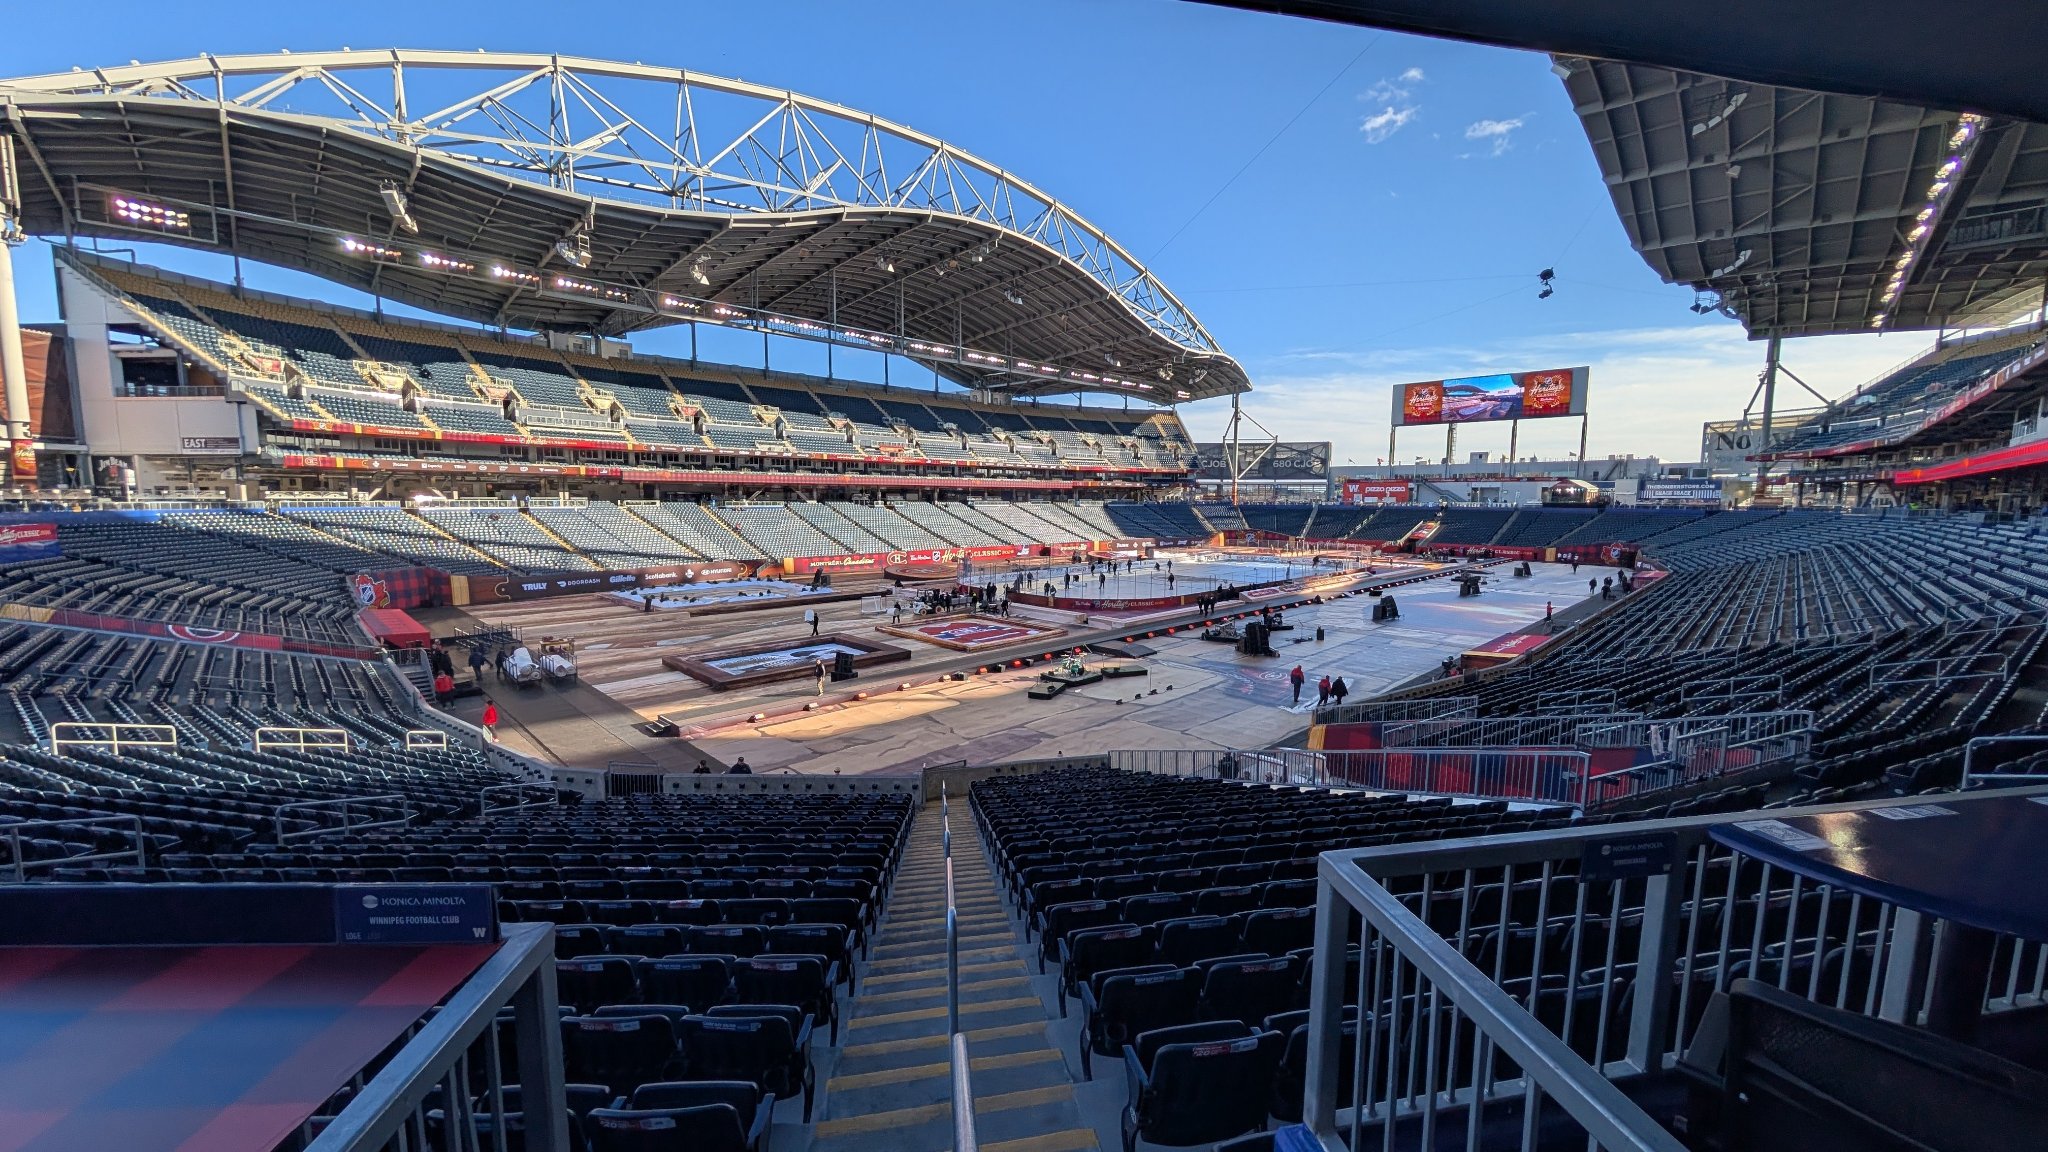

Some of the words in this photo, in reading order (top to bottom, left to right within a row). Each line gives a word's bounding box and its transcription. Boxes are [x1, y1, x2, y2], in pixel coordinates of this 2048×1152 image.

[184, 438, 206, 448] EAST
[1201, 460, 1227, 468] CJOB
[1272, 460, 1291, 468] 680
[1385, 486, 1406, 494] pizza
[973, 549, 1001, 557] CLASSIC
[610, 575, 636, 583] Gillette
[522, 582, 547, 591] TRULY
[382, 898, 420, 906] KONICA
[422, 896, 466, 905] MINOLTA
[369, 916, 405, 925] WINNIPEG
[405, 916, 440, 924] FOOTBALL
[441, 915, 460, 924] CLUB
[472, 927, 486, 938] W
